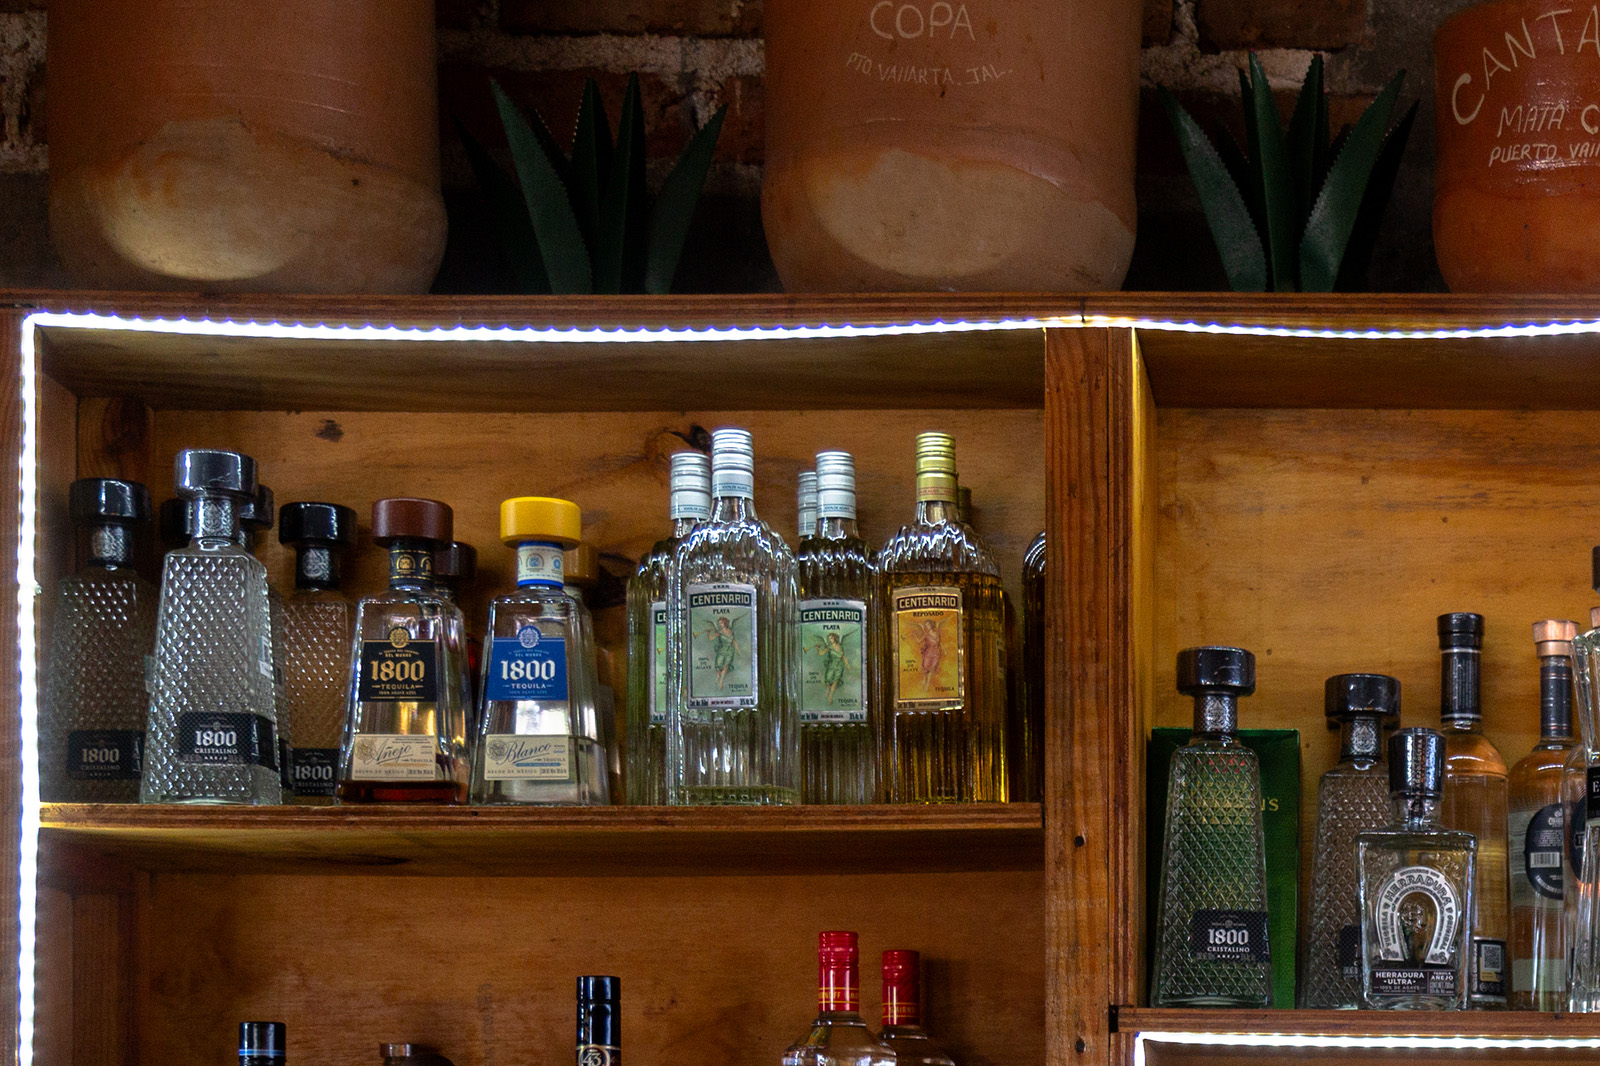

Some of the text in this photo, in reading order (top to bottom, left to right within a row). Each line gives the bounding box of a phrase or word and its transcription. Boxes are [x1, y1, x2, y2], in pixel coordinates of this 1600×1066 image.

[869, 1, 976, 42] COPA
[692, 593, 750, 606] CENTENARIO
[899, 596, 956, 609] CENTENARIO
[803, 609, 860, 622] CENTENARIO
[370, 659, 425, 683] 1800
[500, 659, 556, 683] 1800
[195, 730, 238, 748] 1800
[82, 746, 121, 764] 1800
[194, 747, 239, 755] CRISTALINO
[364, 742, 412, 765] Añejo
[497, 741, 552, 765] Blanco
[80, 764, 122, 772] CRISTALINO
[294, 764, 333, 781] 1800
[293, 780, 334, 788] CRISTALINO
[1207, 927, 1249, 945] 1800
[1207, 945, 1251, 953] CRISTALINO
[1375, 971, 1425, 979] HERRADURA
[1388, 978, 1413, 986] ULTRA
[581, 1051, 602, 1066] 43
